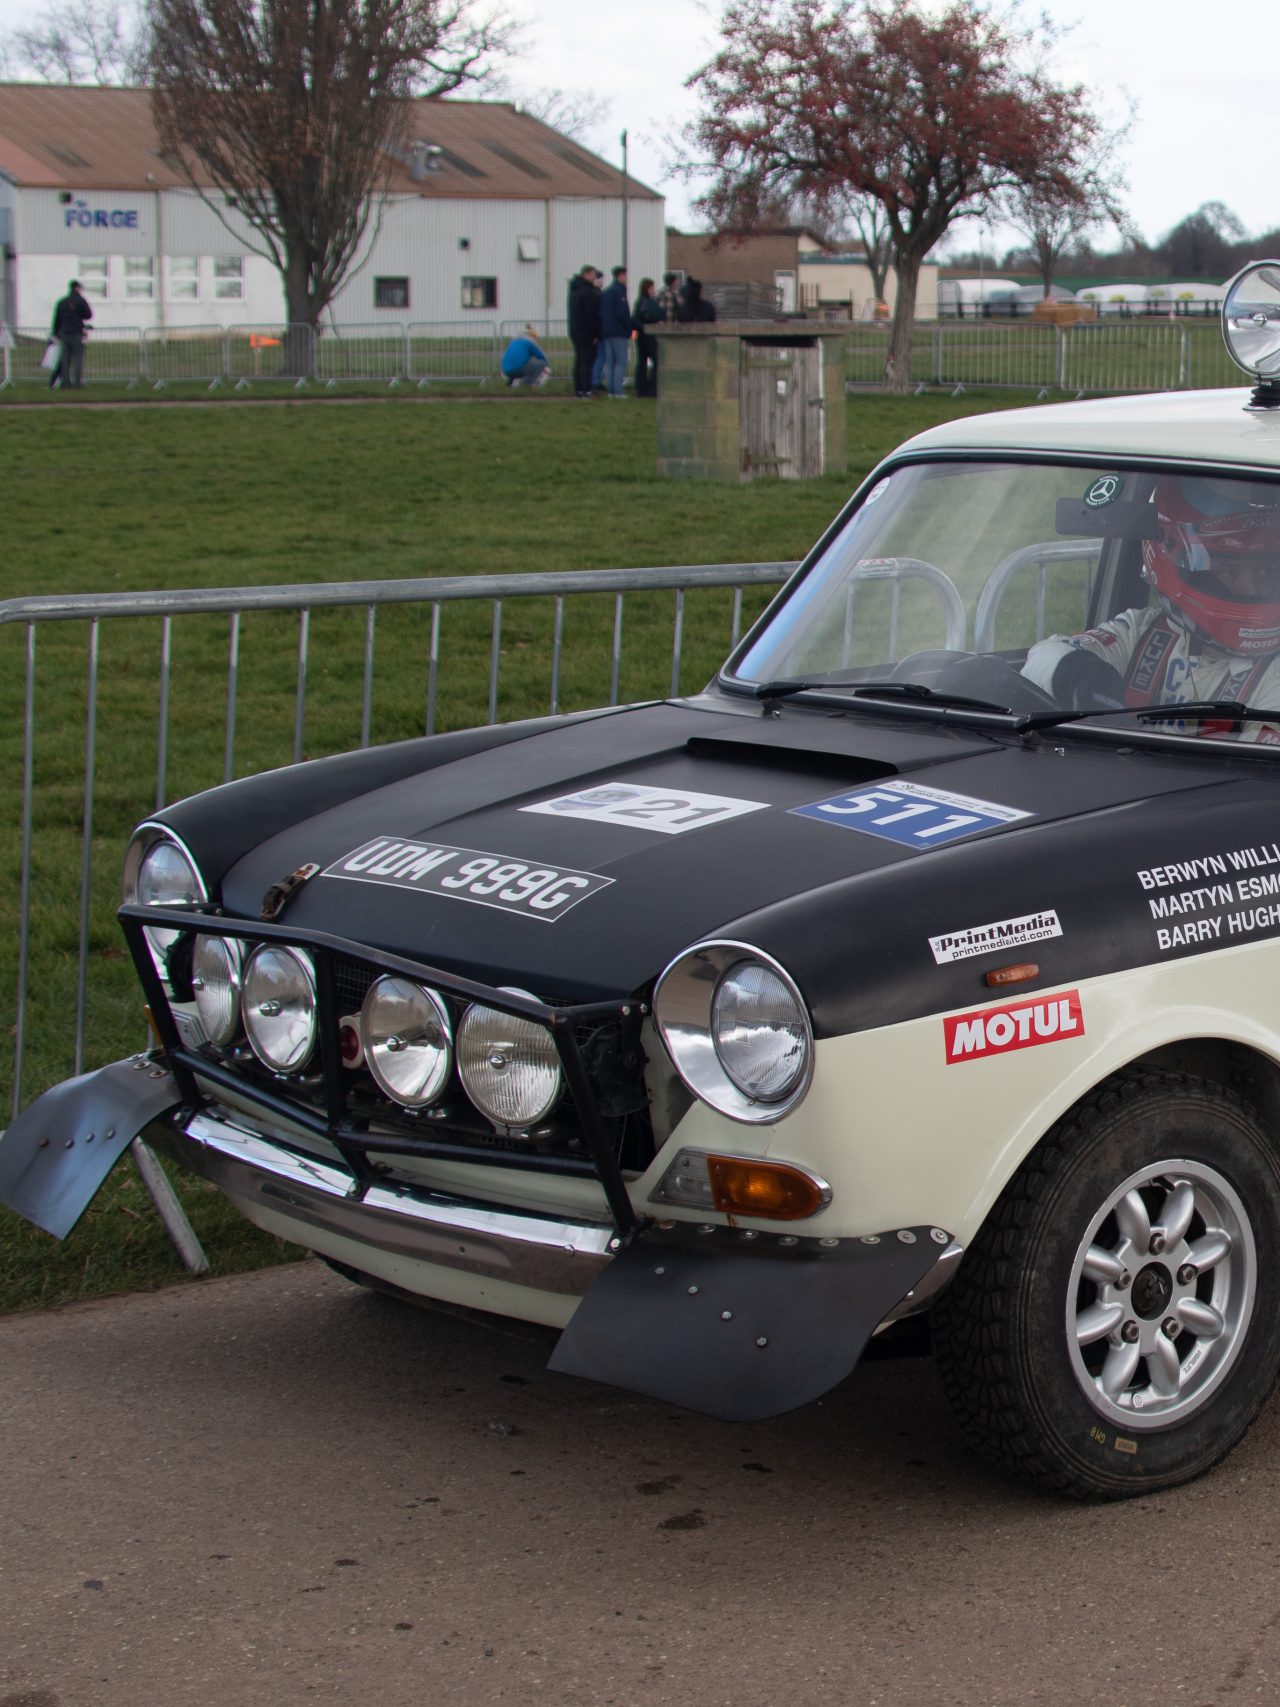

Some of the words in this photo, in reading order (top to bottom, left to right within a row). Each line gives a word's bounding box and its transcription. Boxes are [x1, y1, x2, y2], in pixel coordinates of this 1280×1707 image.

[64, 209, 138, 228] FORGE
[608, 799, 731, 825] 21
[816, 791, 983, 838] 511
[343, 841, 460, 881] UDM
[440, 858, 590, 910] 999G
[1137, 855, 1228, 890] BERWYN
[1149, 884, 1234, 919] MARTYN
[940, 914, 1056, 952] PrintMedia
[951, 928, 1053, 960] printmedialtd.com
[1156, 916, 1222, 950] BARRY
[951, 999, 1078, 1056] MOTUL
